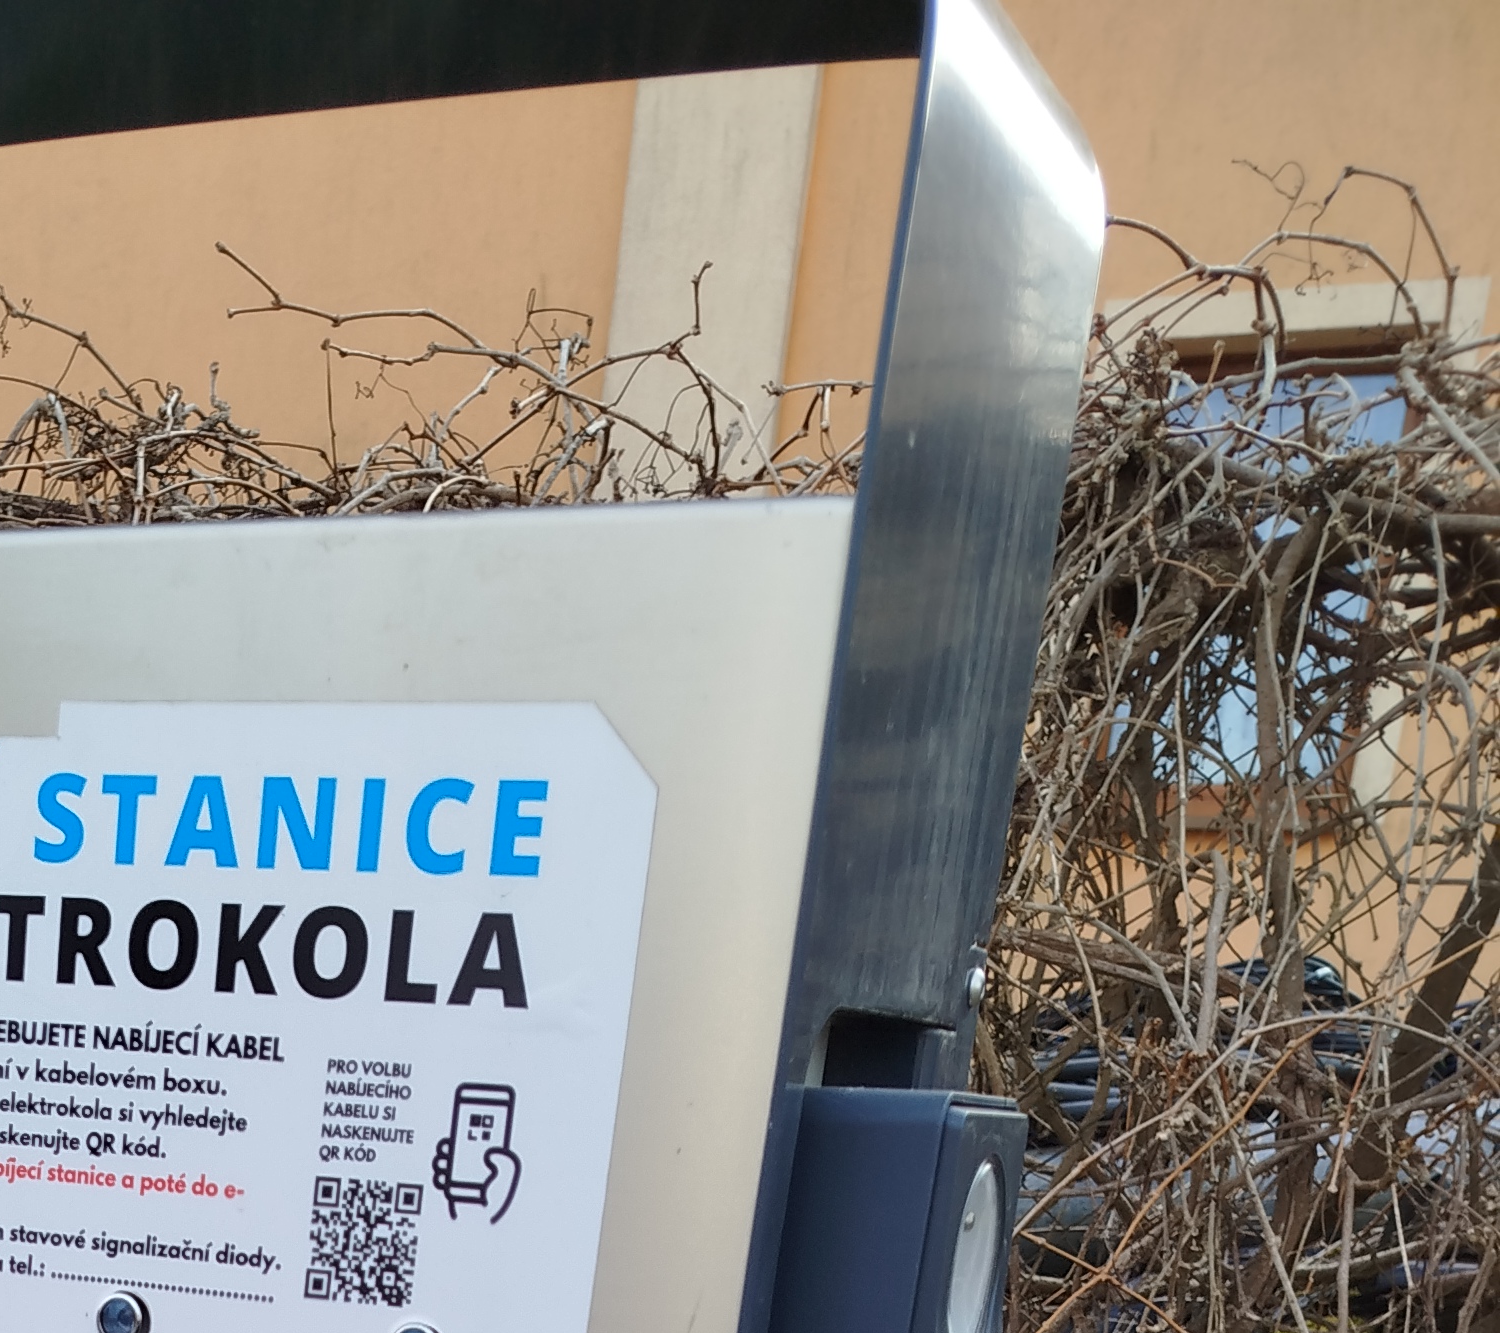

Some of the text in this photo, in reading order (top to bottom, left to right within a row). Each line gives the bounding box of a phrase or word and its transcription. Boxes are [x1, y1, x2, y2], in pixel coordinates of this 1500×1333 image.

[34, 772, 549, 878] STANICE
[93, 1020, 202, 1056] NABÍJECÍ
[206, 1033, 284, 1062] KABEL
[16, 1066, 30, 1080] v
[35, 1058, 156, 1090] kabelovém
[163, 1068, 227, 1096] boxu.
[327, 1059, 411, 1078] PRO VOLBU
[325, 1077, 411, 1100] NABÍJECÍHO
[0, 1091, 112, 1120] elektrokola
[118, 1101, 134, 1122] si
[139, 1103, 247, 1136] vyhledejte
[323, 1102, 396, 1121] KABELU SI
[86, 1132, 116, 1157] QR
[122, 1133, 166, 1158] kód.
[321, 1124, 414, 1144] NASKENUJTE
[319, 1143, 376, 1162] QR KÓD
[47, 1164, 116, 1187] stanice
[122, 1175, 134, 1188] a
[140, 1173, 186, 1196] poté
[192, 1174, 218, 1197] do
[224, 1185, 244, 1199] e-
[9, 1225, 85, 1249] stavové
[91, 1231, 213, 1262] signalizační
[216, 1243, 282, 1274] diody.
